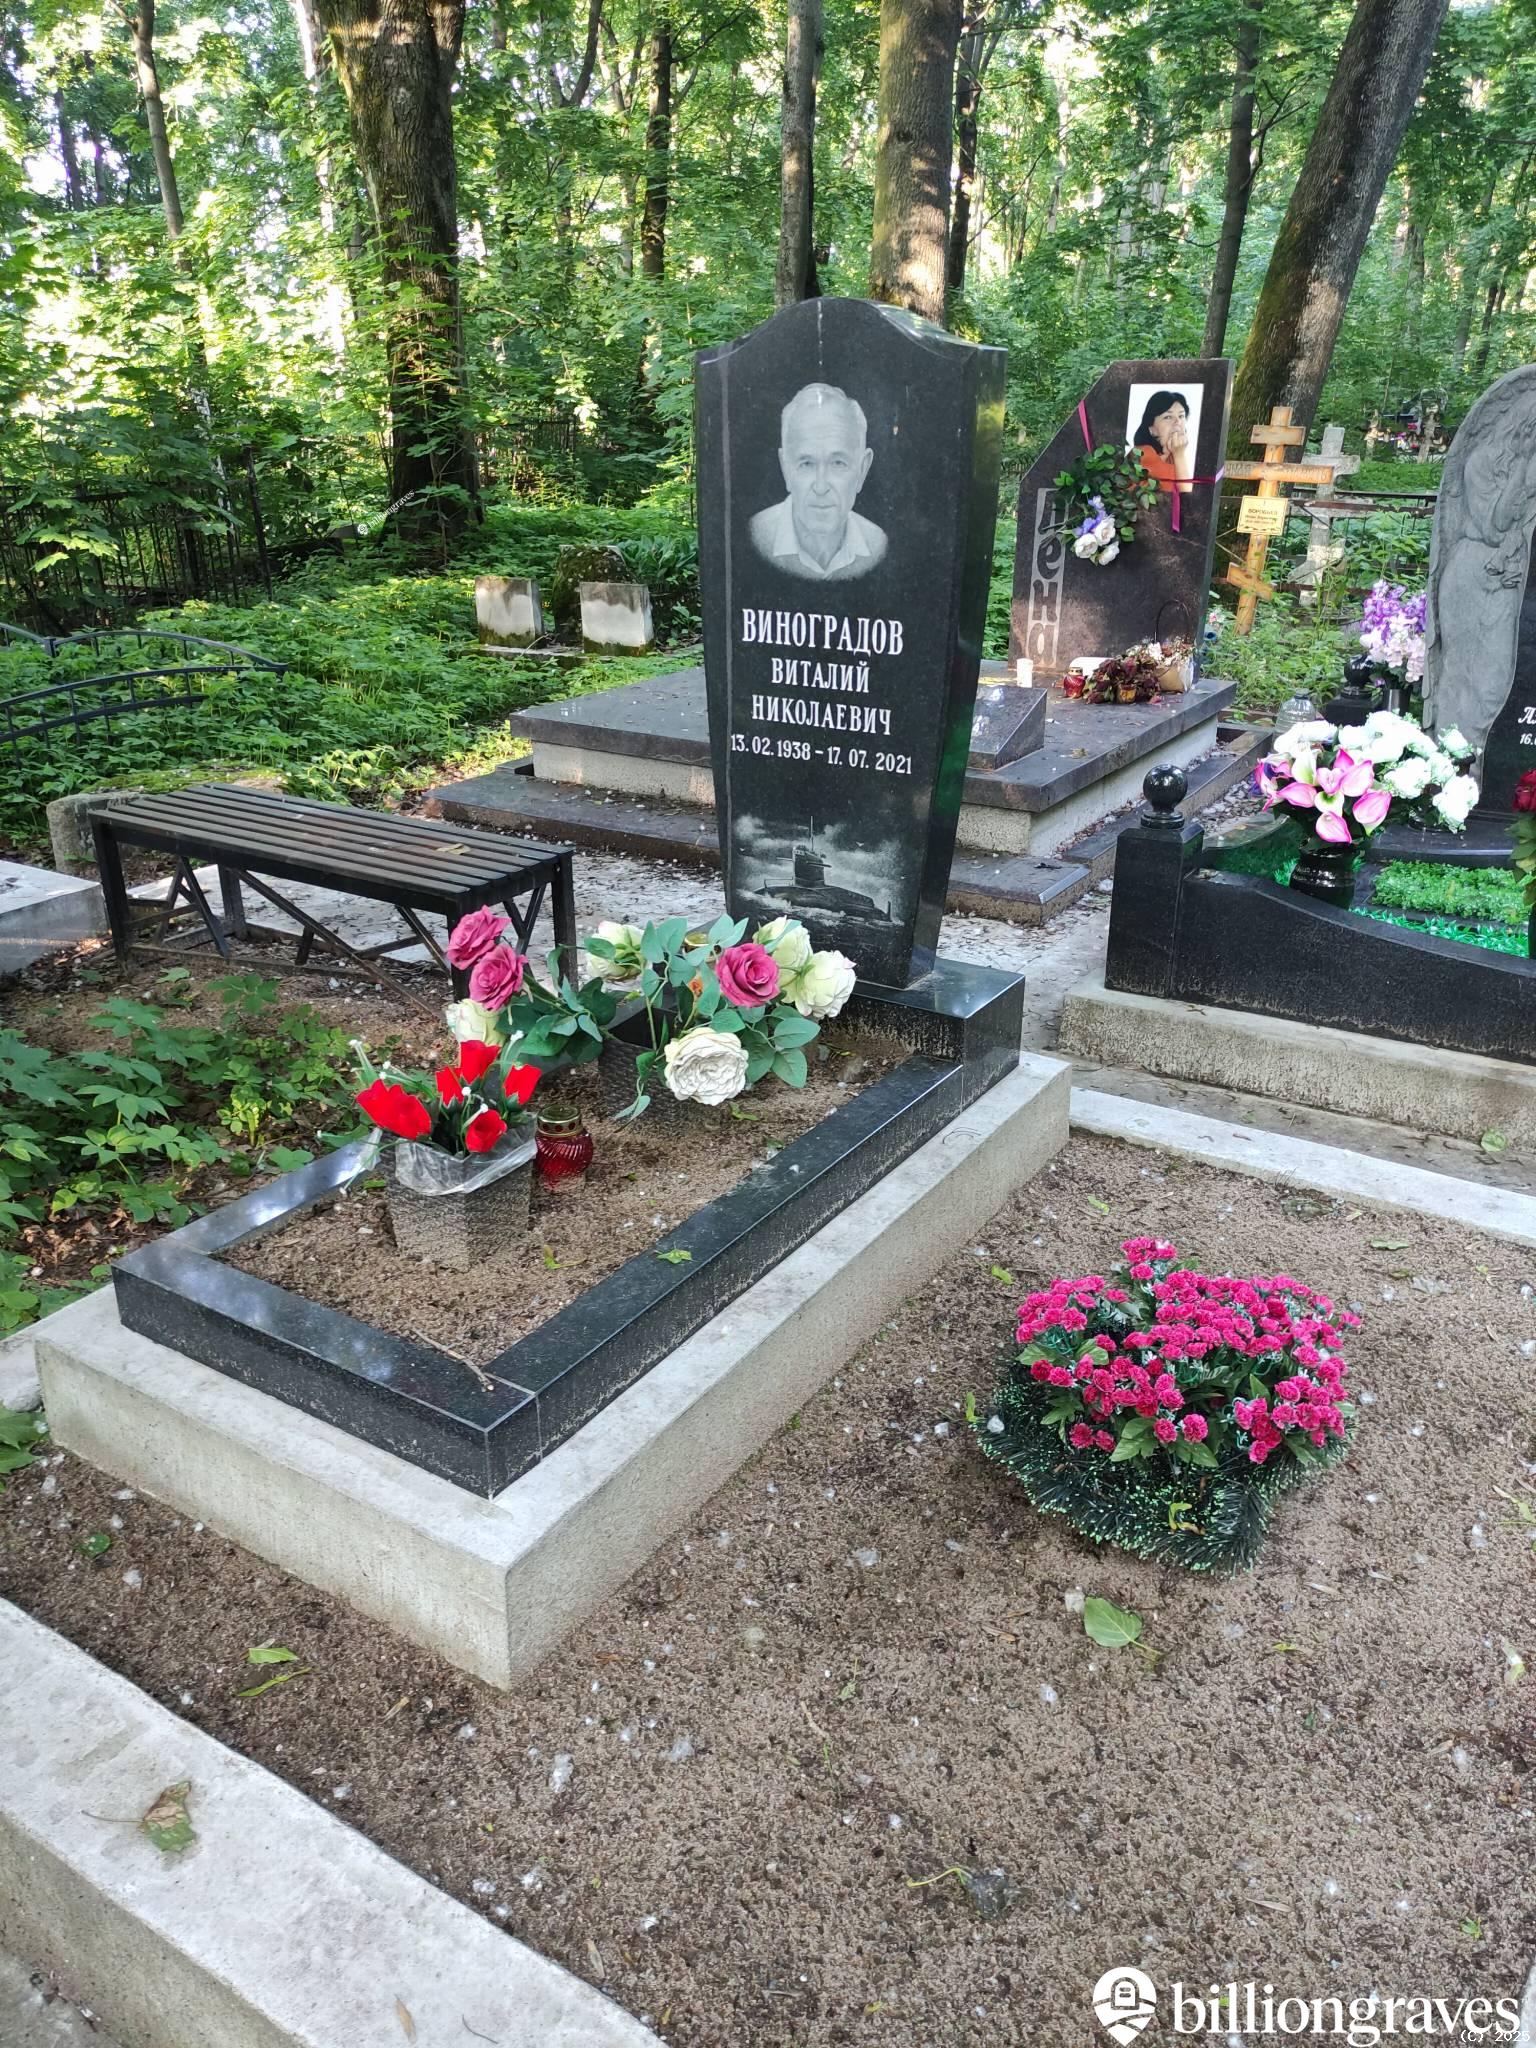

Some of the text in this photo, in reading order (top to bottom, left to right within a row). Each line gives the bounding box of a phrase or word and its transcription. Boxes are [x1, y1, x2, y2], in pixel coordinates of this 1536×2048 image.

[742, 608, 904, 656] ВИНОГРАДОВ
[771, 657, 870, 693] ВИТАЛИЙ
[752, 694, 891, 735] НИКОЛАЕВИЧ
